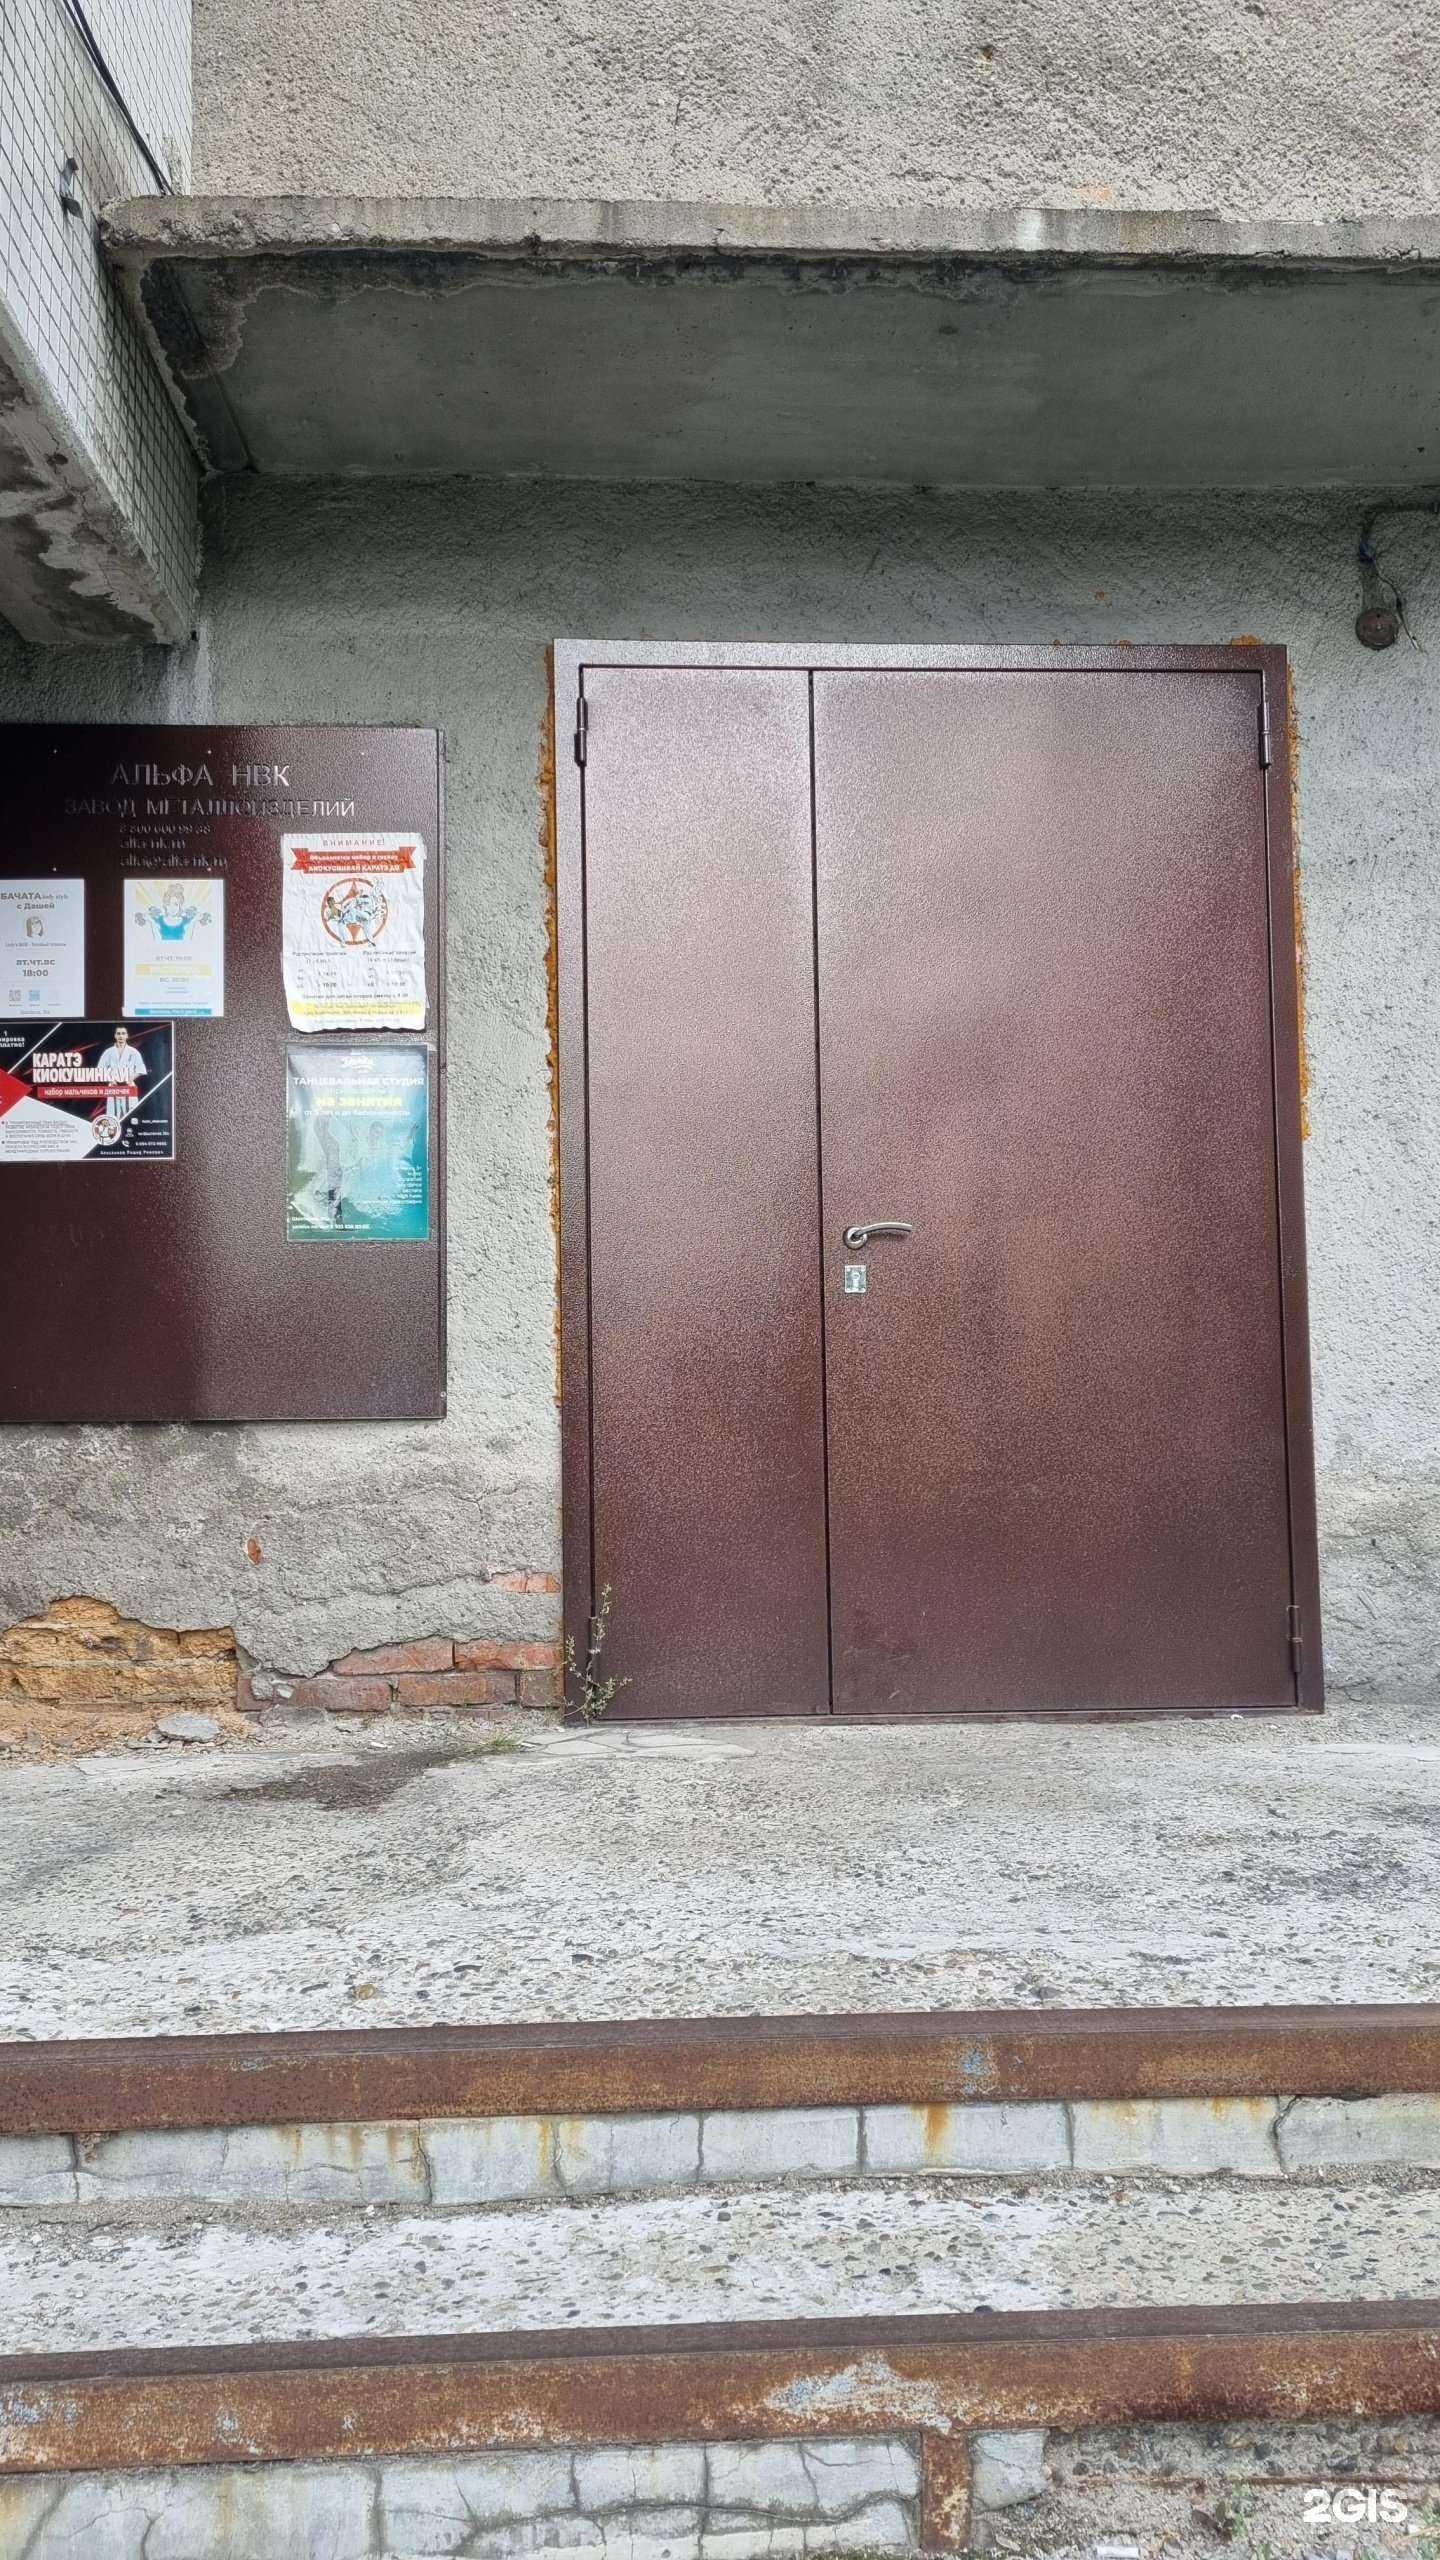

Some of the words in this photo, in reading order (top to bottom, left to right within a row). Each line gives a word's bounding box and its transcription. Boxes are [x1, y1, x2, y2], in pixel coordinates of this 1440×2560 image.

[111, 763, 214, 787] АЛЬФА
[231, 763, 291, 787] НВК
[64, 797, 137, 818] ЗАВОД
[322, 838, 385, 847] ВНИМАНИЕ!
[0, 891, 41, 901] БАЧАТА
[22, 969, 49, 977] 18:00
[32, 1052, 83, 1068] КАРАТЭ
[32, 1067, 130, 1083] КИОКУШИНКАЙ
